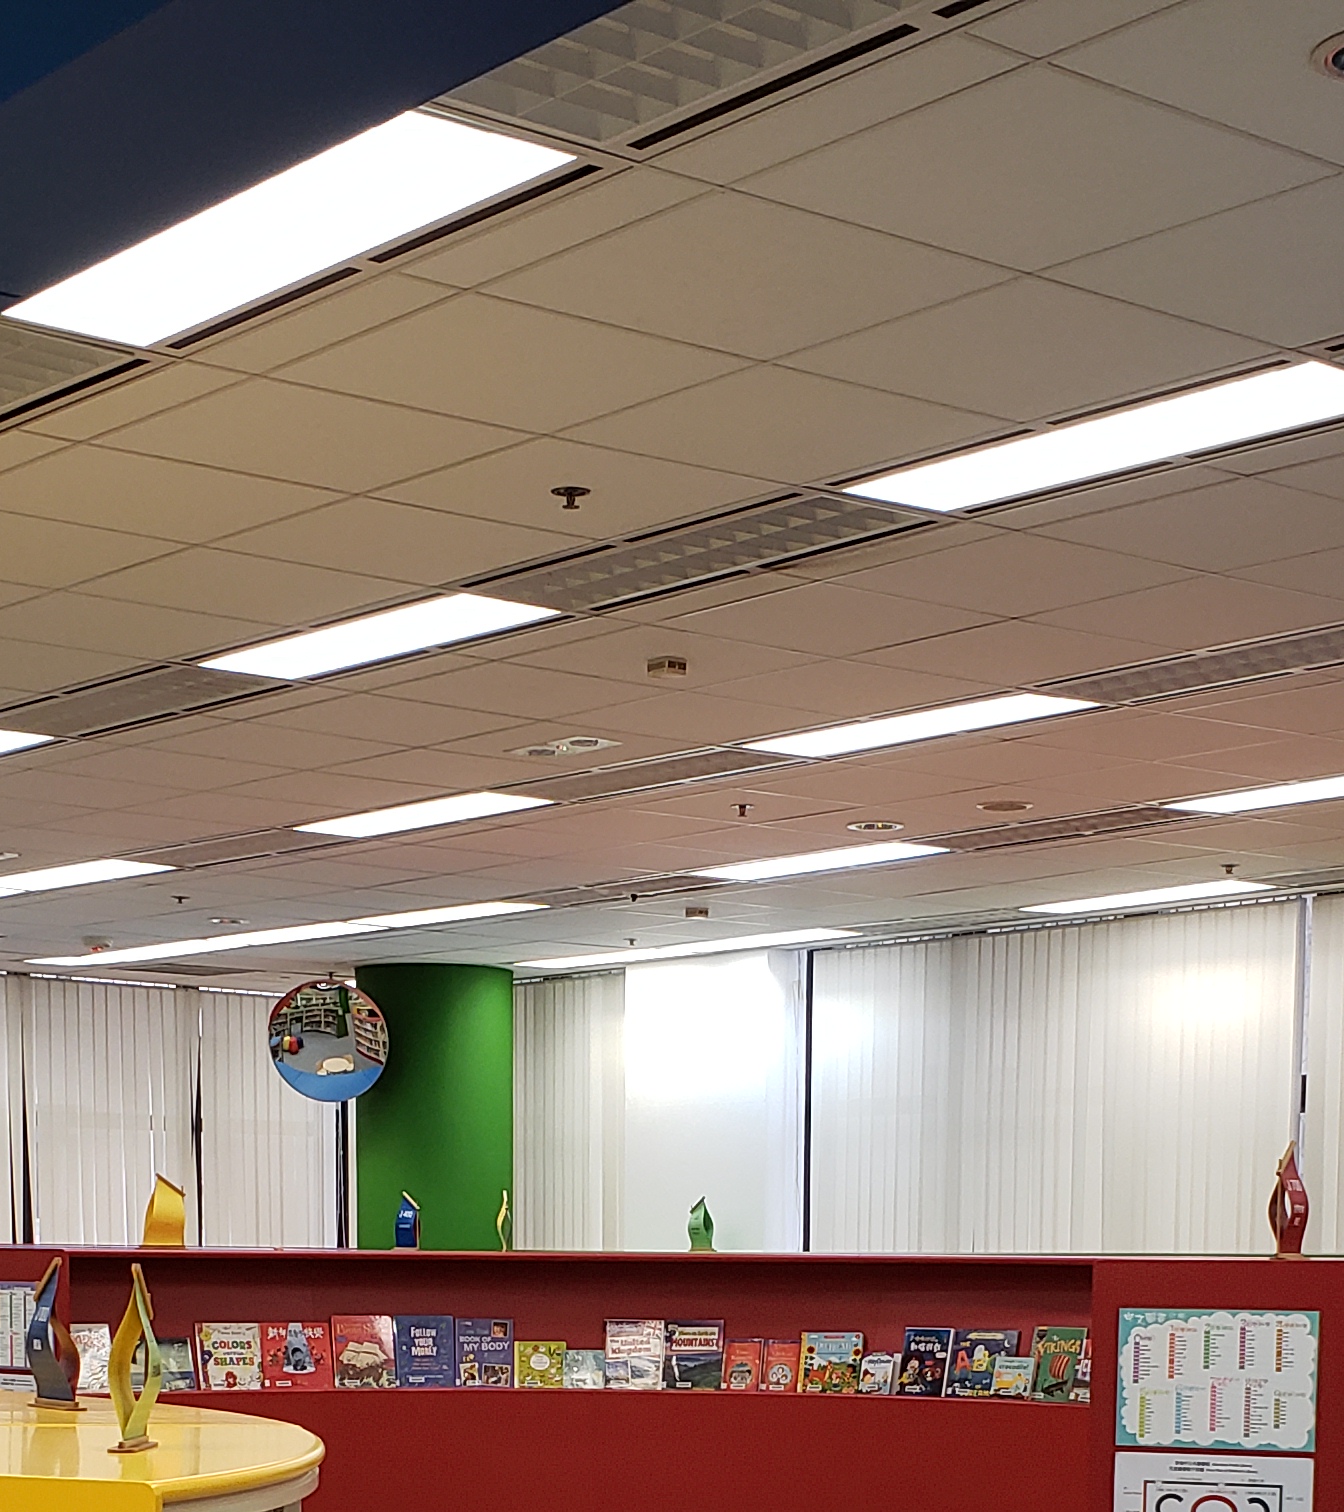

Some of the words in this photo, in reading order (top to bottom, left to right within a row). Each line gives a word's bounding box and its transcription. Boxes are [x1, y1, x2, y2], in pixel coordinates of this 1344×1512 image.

[410, 1326, 437, 1337] FOLLOW
[212, 1340, 253, 1351] COLORS
[463, 1343, 480, 1352] MY
[481, 1341, 510, 1351] BODY
[213, 1356, 255, 1367] SHAPES
